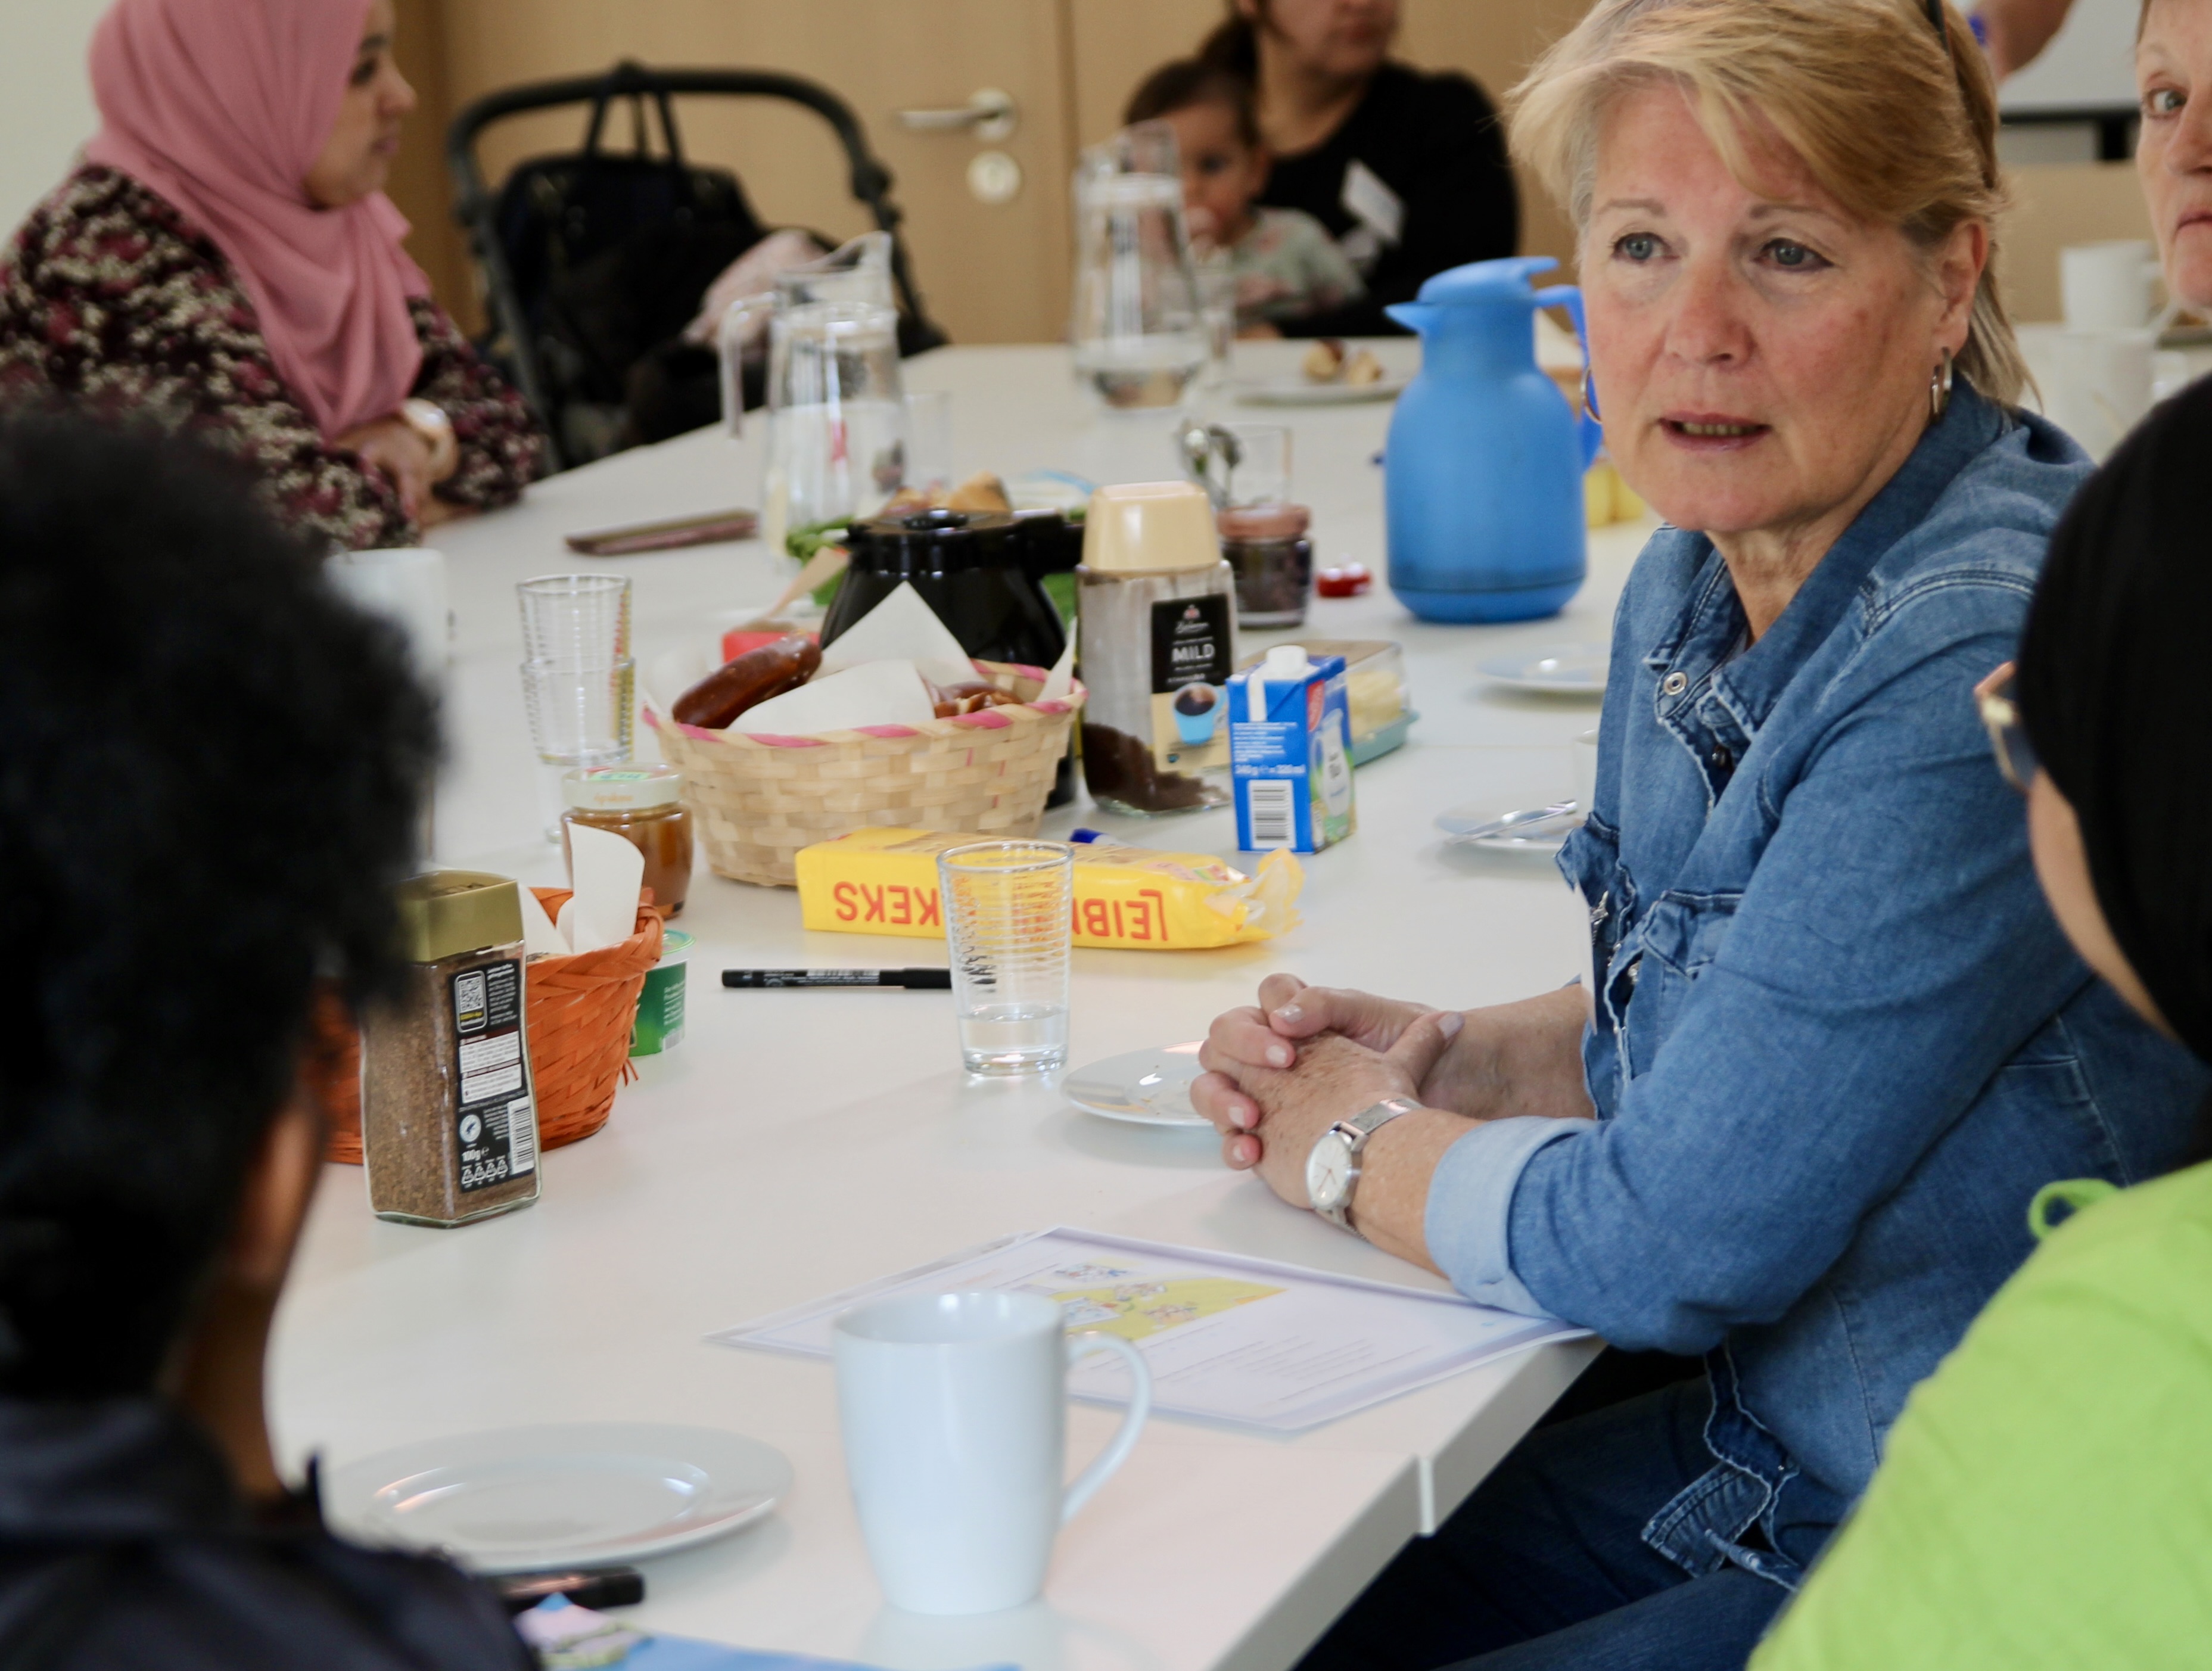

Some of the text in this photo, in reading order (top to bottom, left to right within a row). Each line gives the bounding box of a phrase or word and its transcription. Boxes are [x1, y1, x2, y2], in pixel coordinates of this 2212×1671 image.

[1172, 644, 1215, 662] MILD
[833, 881, 1168, 941] LEIB KEKS
